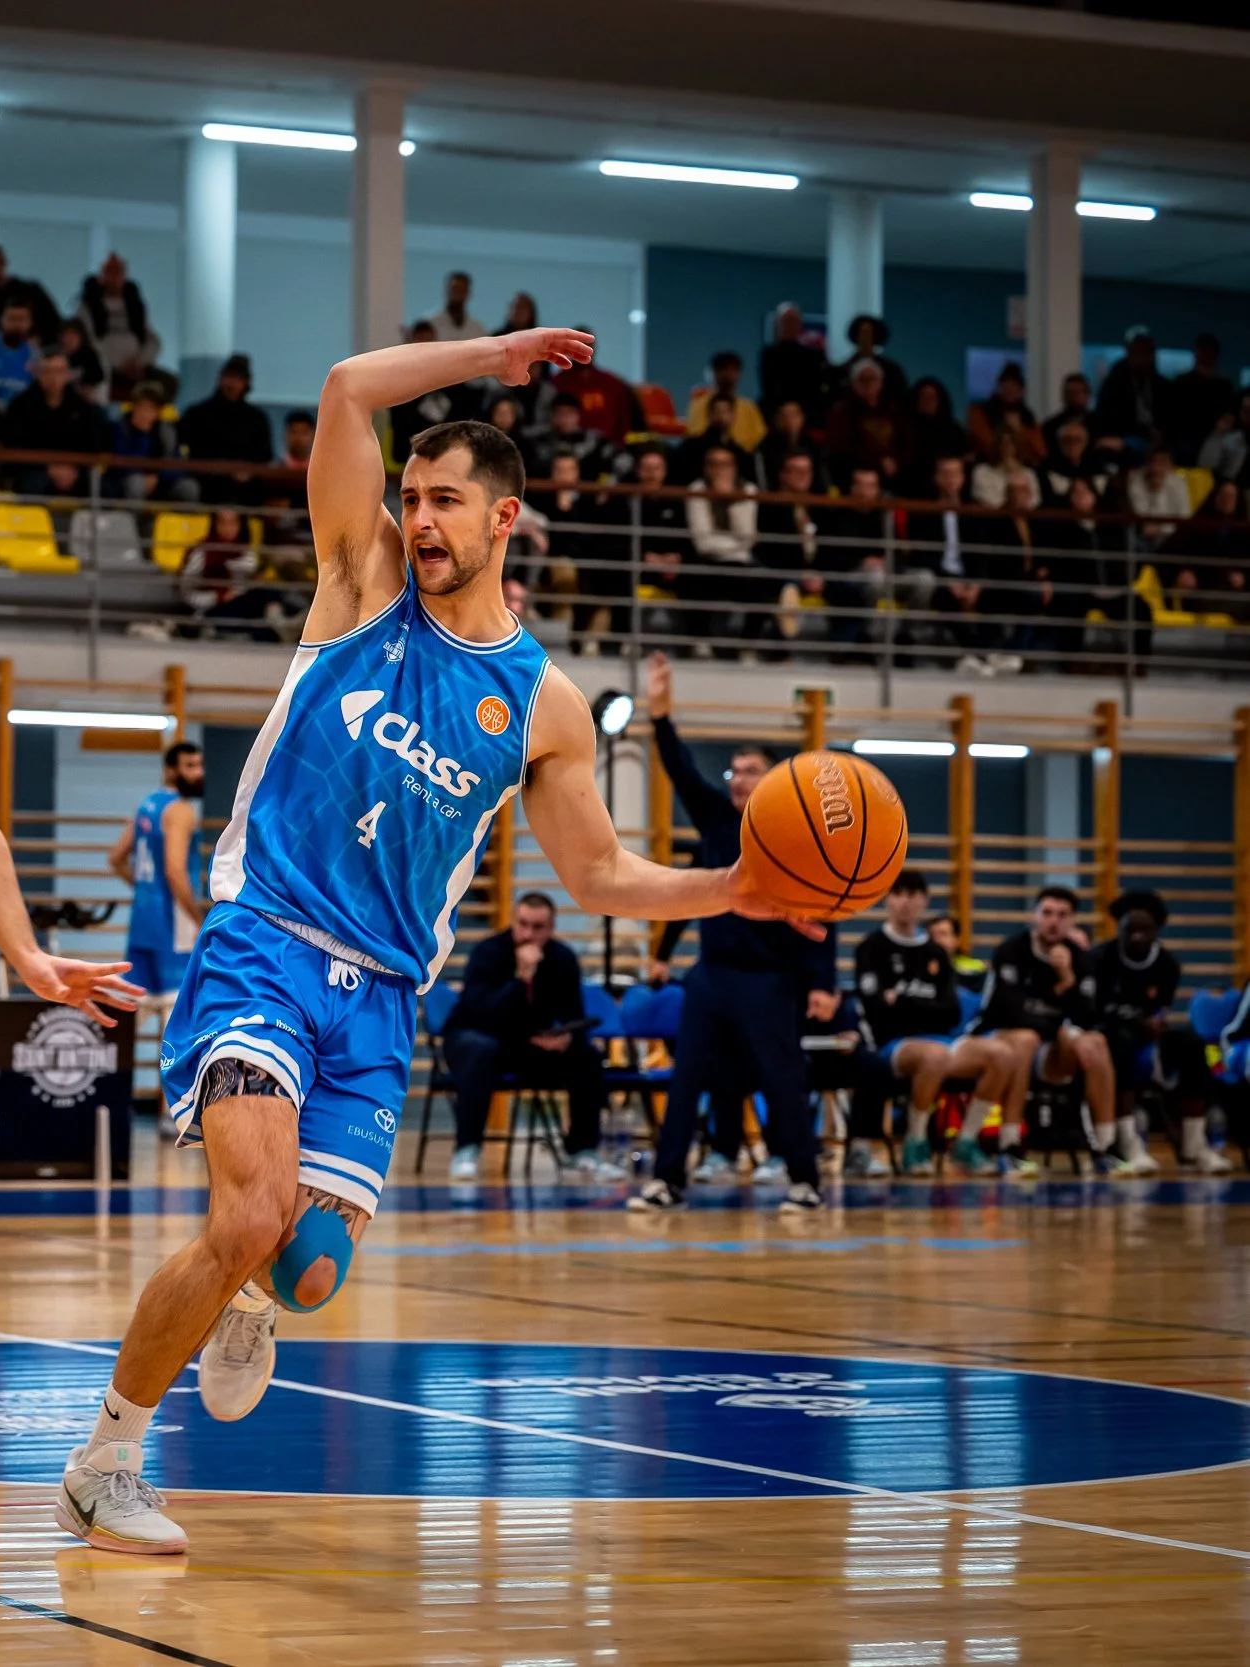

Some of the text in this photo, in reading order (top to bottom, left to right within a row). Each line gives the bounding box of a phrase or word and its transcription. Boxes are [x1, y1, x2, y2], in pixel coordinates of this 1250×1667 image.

[402, 774, 433, 804] Rent
[440, 804, 462, 819] car
[356, 800, 387, 849] 4
[347, 1125, 384, 1147] EBUSUS
